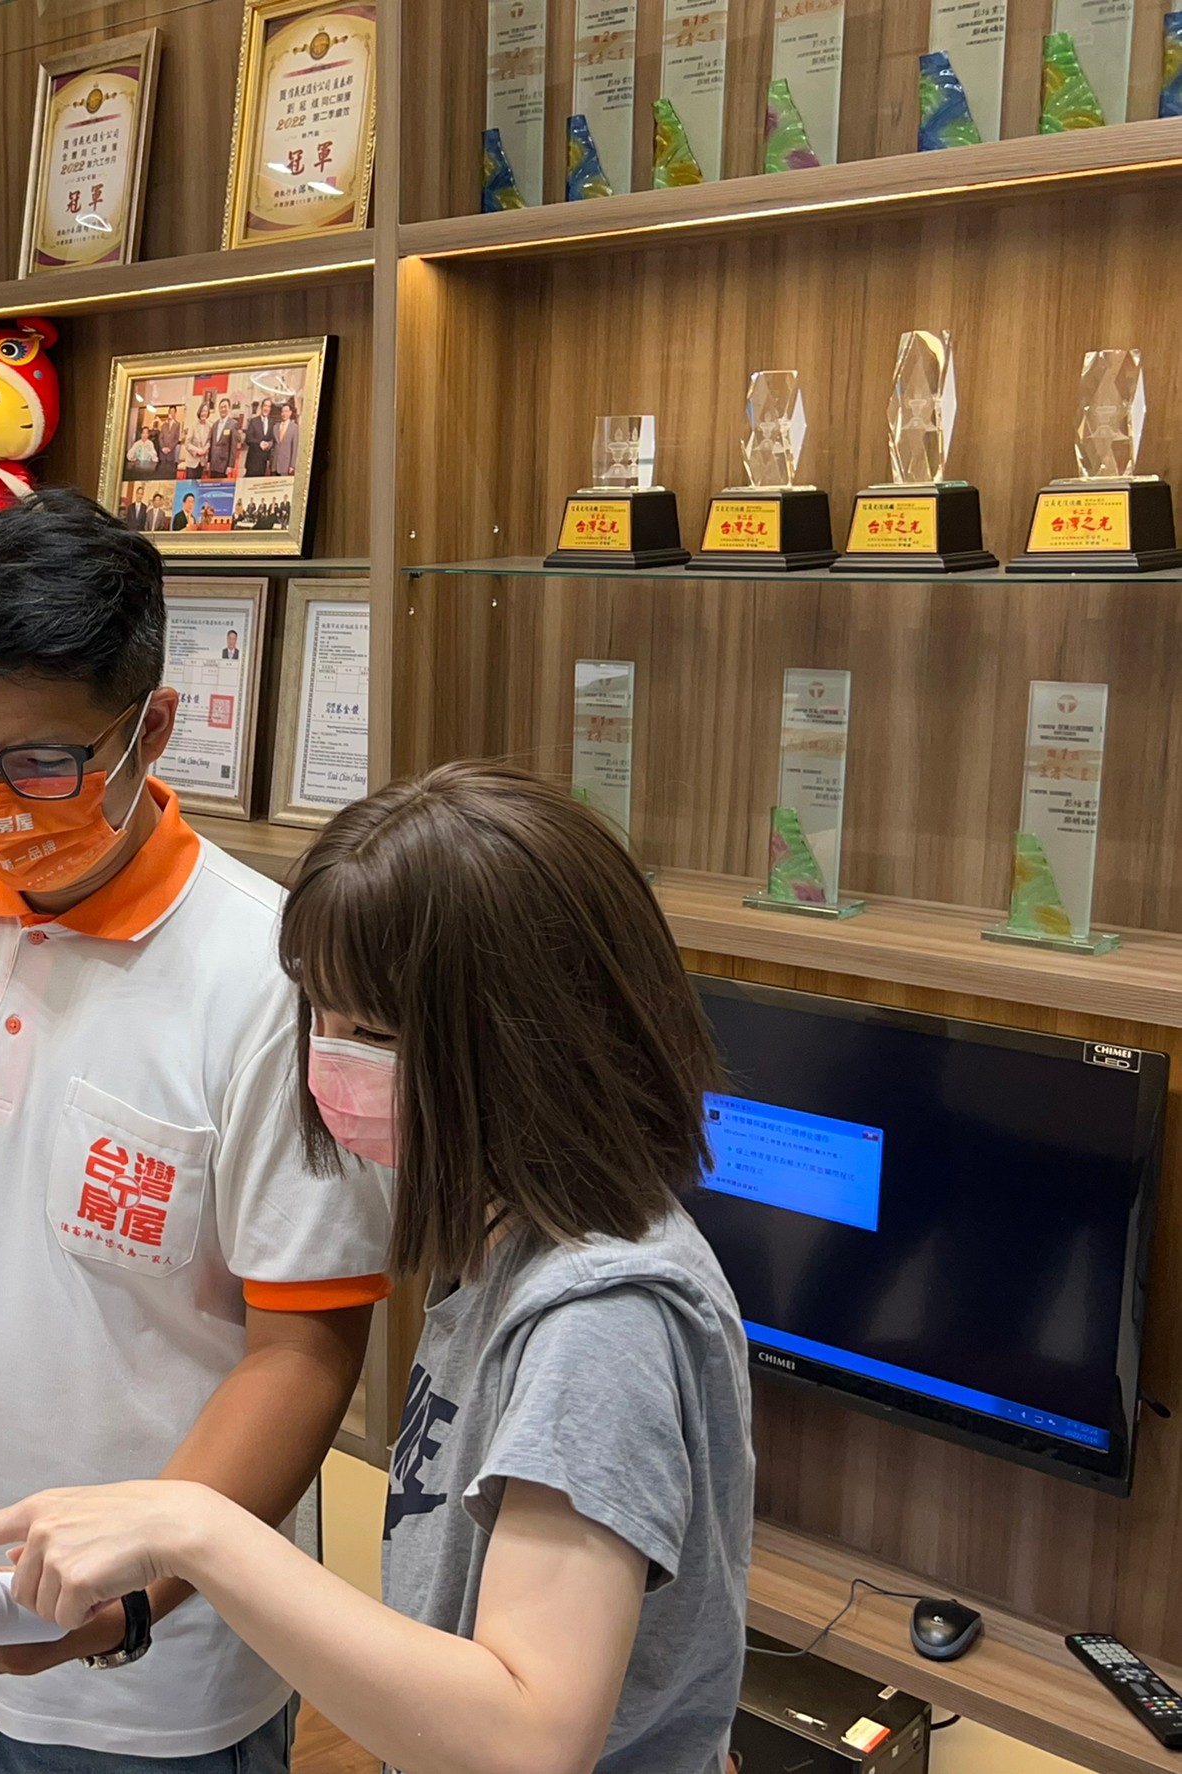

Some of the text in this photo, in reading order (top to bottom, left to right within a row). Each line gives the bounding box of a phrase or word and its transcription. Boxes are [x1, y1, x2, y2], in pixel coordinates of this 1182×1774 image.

[275, 115, 307, 131] 2022
[287, 140, 334, 175] 冠軍
[59, 160, 86, 176] 2022
[66, 183, 105, 214] 冠軍
[576, 520, 620, 534] 台灣之光
[720, 521, 768, 535] 台灣之光
[868, 520, 922, 534] 台灣之光
[1051, 516, 1113, 532] 台灣之光
[1094, 1045, 1132, 1059] CHIMEI
[1093, 1055, 1130, 1069] LED
[85, 1136, 177, 1203] 台灣
[77, 1182, 168, 1247] 房屋
[758, 1351, 796, 1371] CHIMEI
